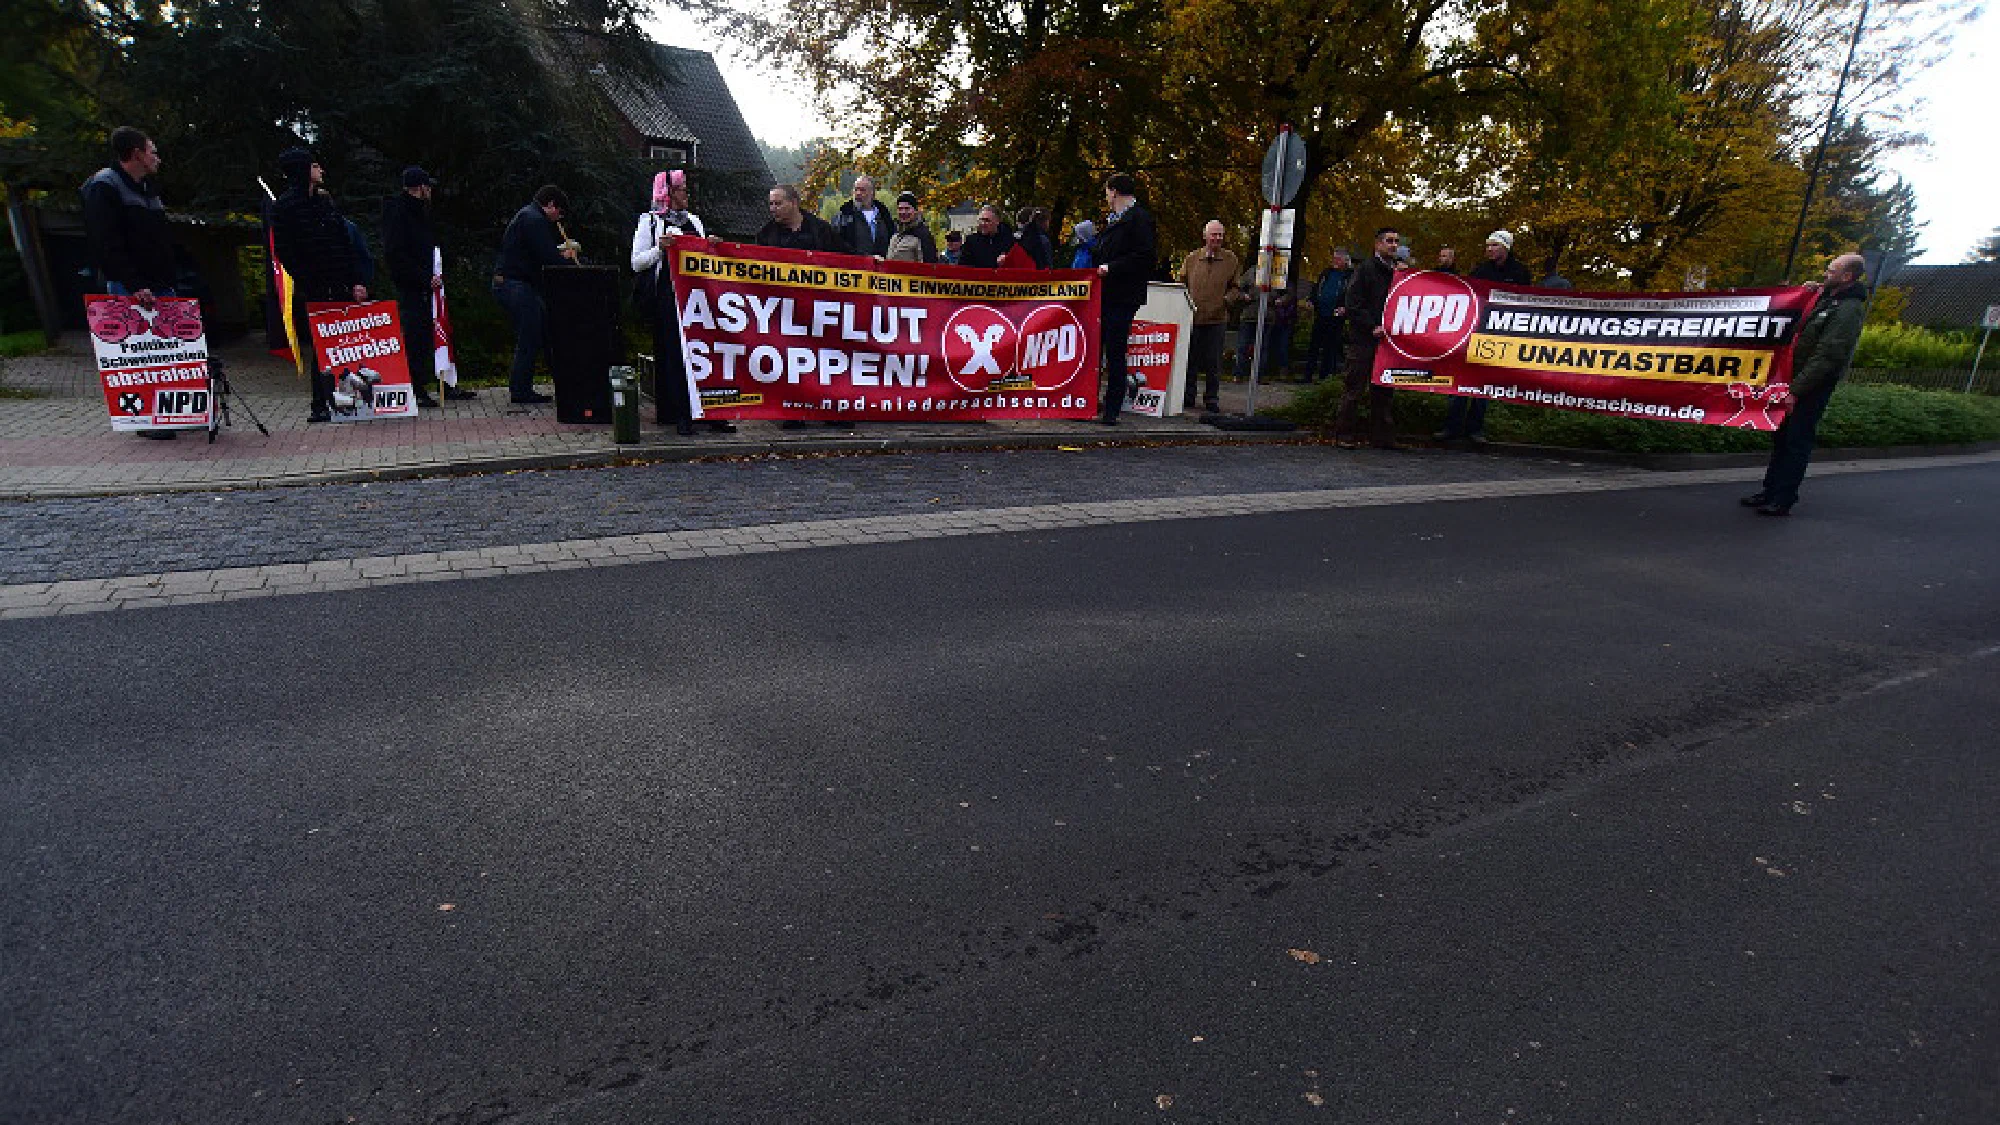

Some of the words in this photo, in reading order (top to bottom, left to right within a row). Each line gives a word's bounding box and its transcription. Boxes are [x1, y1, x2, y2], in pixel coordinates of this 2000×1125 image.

[685, 256, 827, 285] DEUTSCHLAND
[834, 271, 862, 287] IST
[869, 275, 901, 293] KEIN
[909, 279, 1088, 298] EINWANDERUNGSLAND
[317, 312, 392, 337] Heimreise
[682, 288, 928, 343] ASYLFLUT
[1391, 293, 1470, 336] NPD
[1486, 310, 1792, 338] MEINUNGSFREIHEIT
[326, 337, 401, 366] Einreise
[686, 339, 930, 387] STOPPEN!
[1021, 324, 1076, 370] NPD
[1475, 339, 1513, 359] IST
[1518, 344, 1742, 377] UNANTASTBAR
[158, 391, 208, 413] NPD
[375, 391, 408, 408] NPD
[782, 394, 1088, 412] www.npd-niedersachsen.de
[1457, 384, 1705, 420] www.npd-niedersachsen.de
